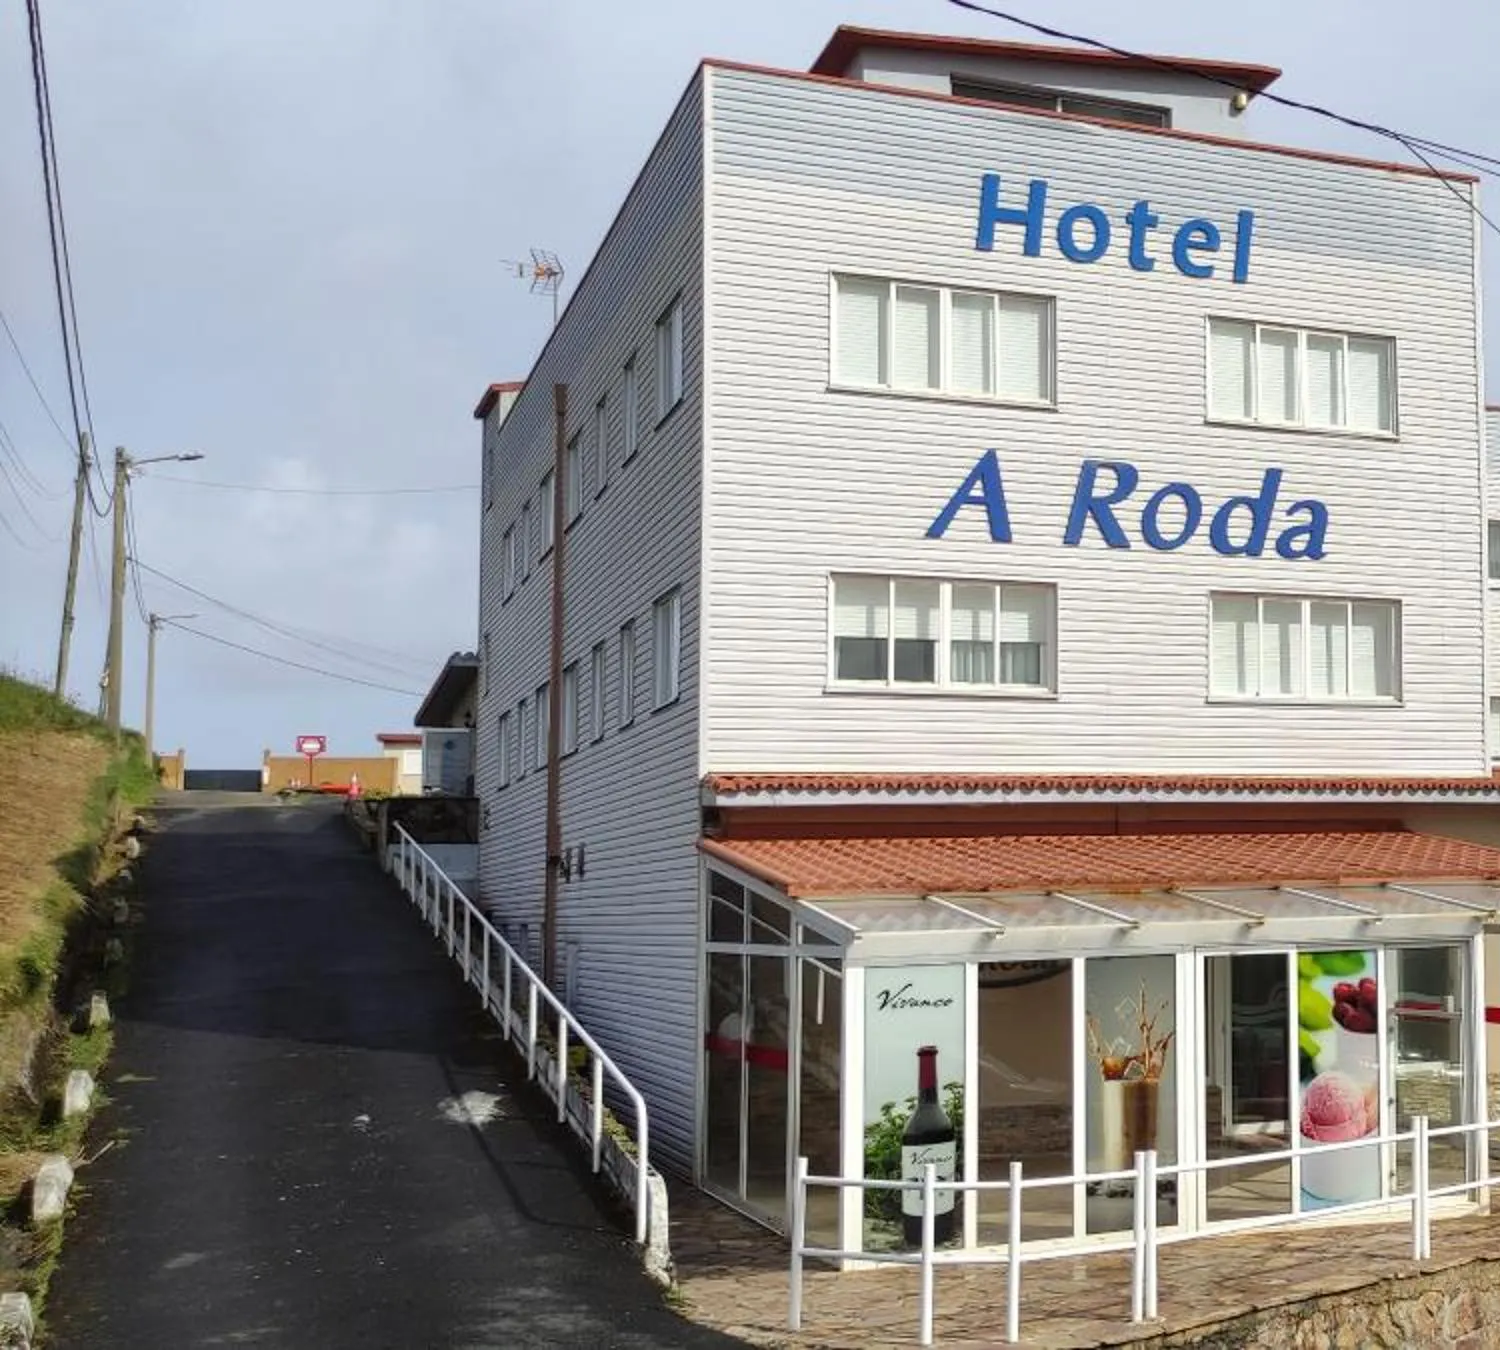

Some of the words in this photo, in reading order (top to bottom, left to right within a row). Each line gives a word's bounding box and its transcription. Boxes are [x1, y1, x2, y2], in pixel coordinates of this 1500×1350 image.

[975, 173, 1255, 284] Hotel
[925, 448, 1013, 545] A
[1062, 458, 1330, 562] Roda
[876, 982, 954, 1011] Vivanco
